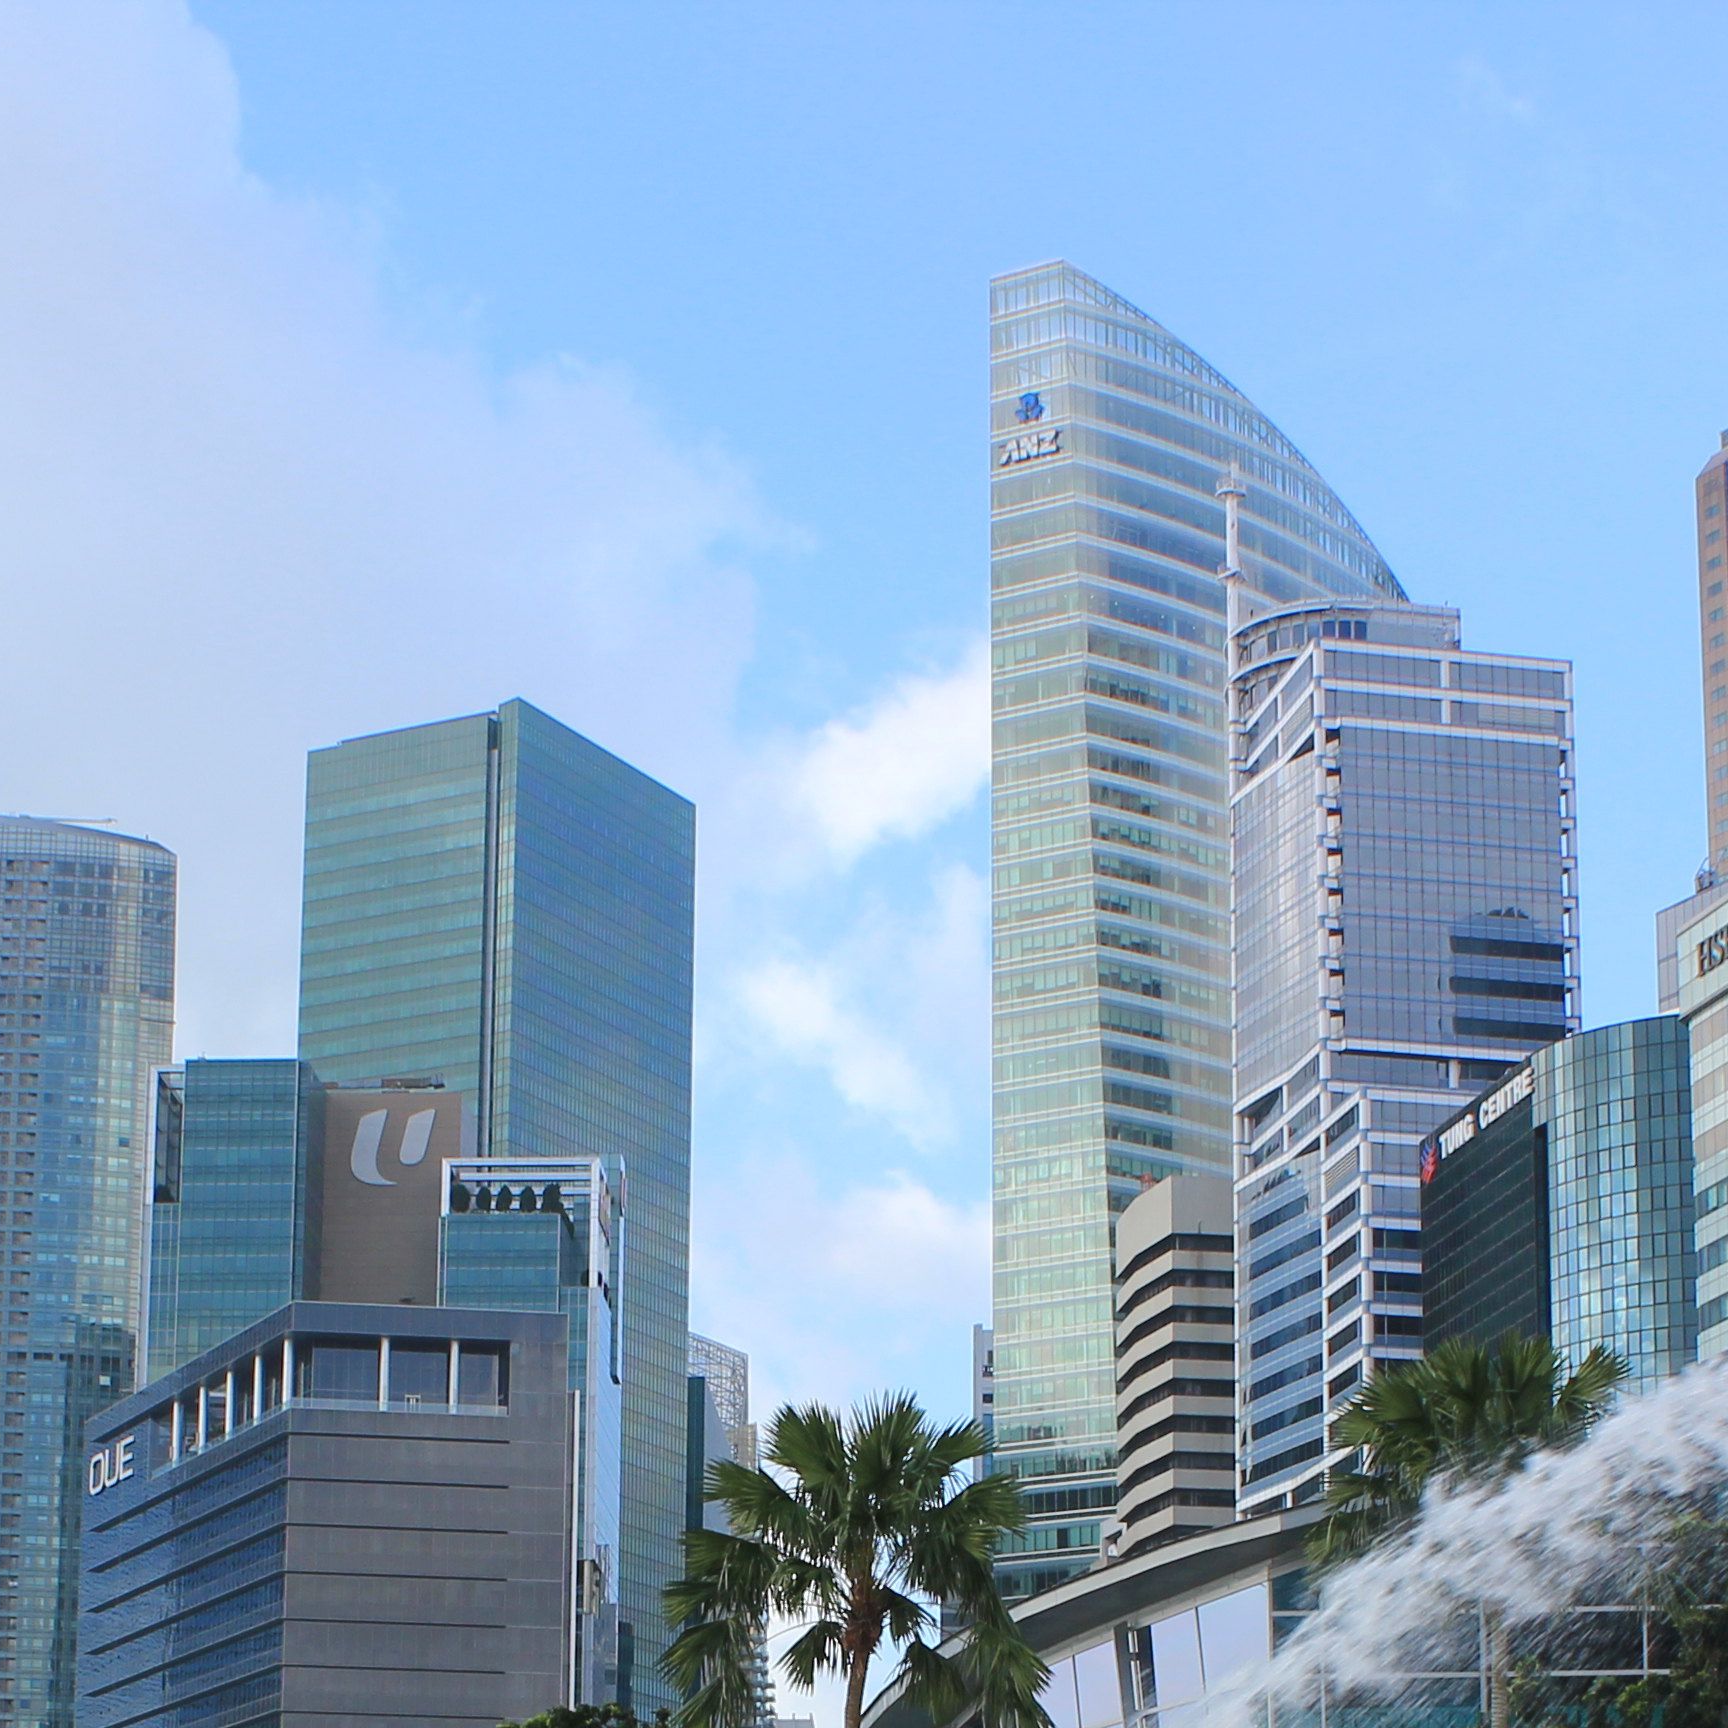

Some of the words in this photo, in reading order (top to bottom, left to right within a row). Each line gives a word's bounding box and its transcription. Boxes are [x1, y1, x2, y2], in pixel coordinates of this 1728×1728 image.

[998, 429, 1061, 467] ANZ
[1438, 1112, 1476, 1160] TUNG
[1478, 1066, 1536, 1131] CENTRE
[89, 1434, 135, 1496] OUE
